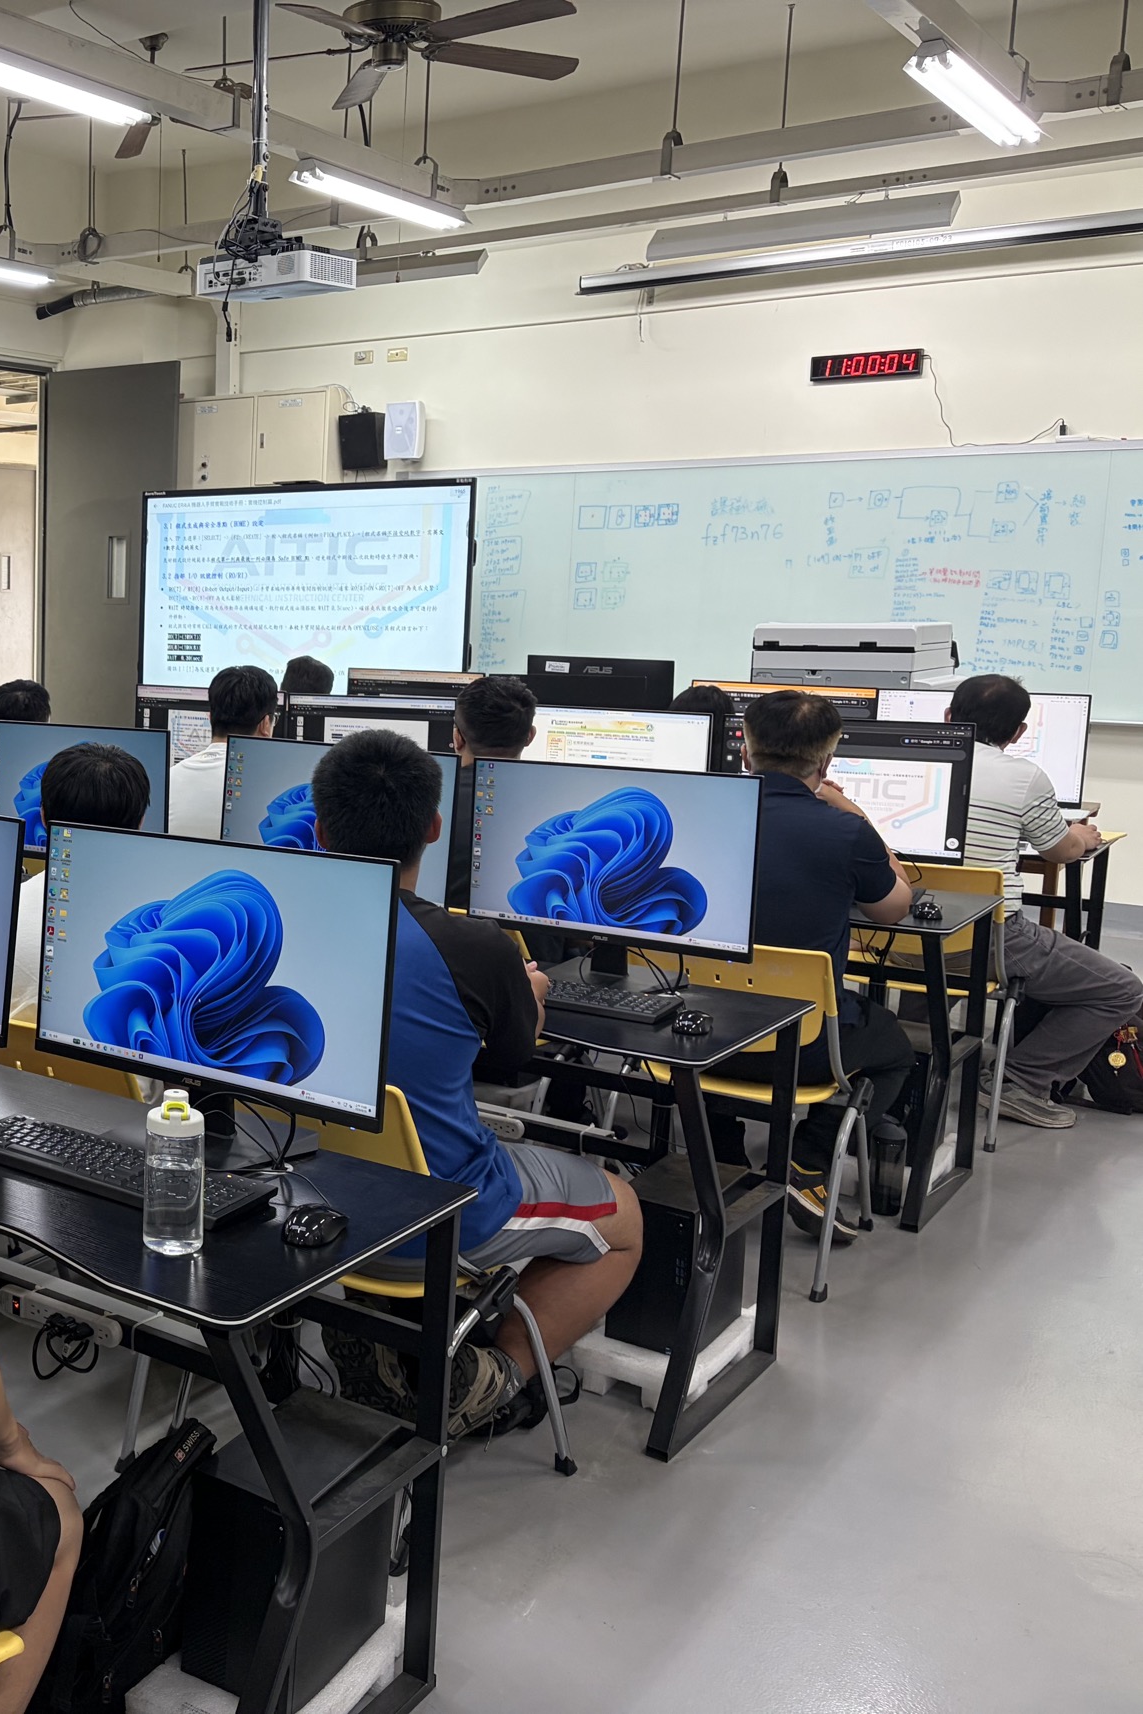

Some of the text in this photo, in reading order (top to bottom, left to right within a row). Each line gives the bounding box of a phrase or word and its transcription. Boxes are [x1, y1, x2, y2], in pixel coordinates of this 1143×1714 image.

[825, 353, 916, 377] 11:00:04
[583, 666, 613, 674] ASUS
[182, 1077, 201, 1087] ASUS
[182, 1430, 200, 1452] SWISS
